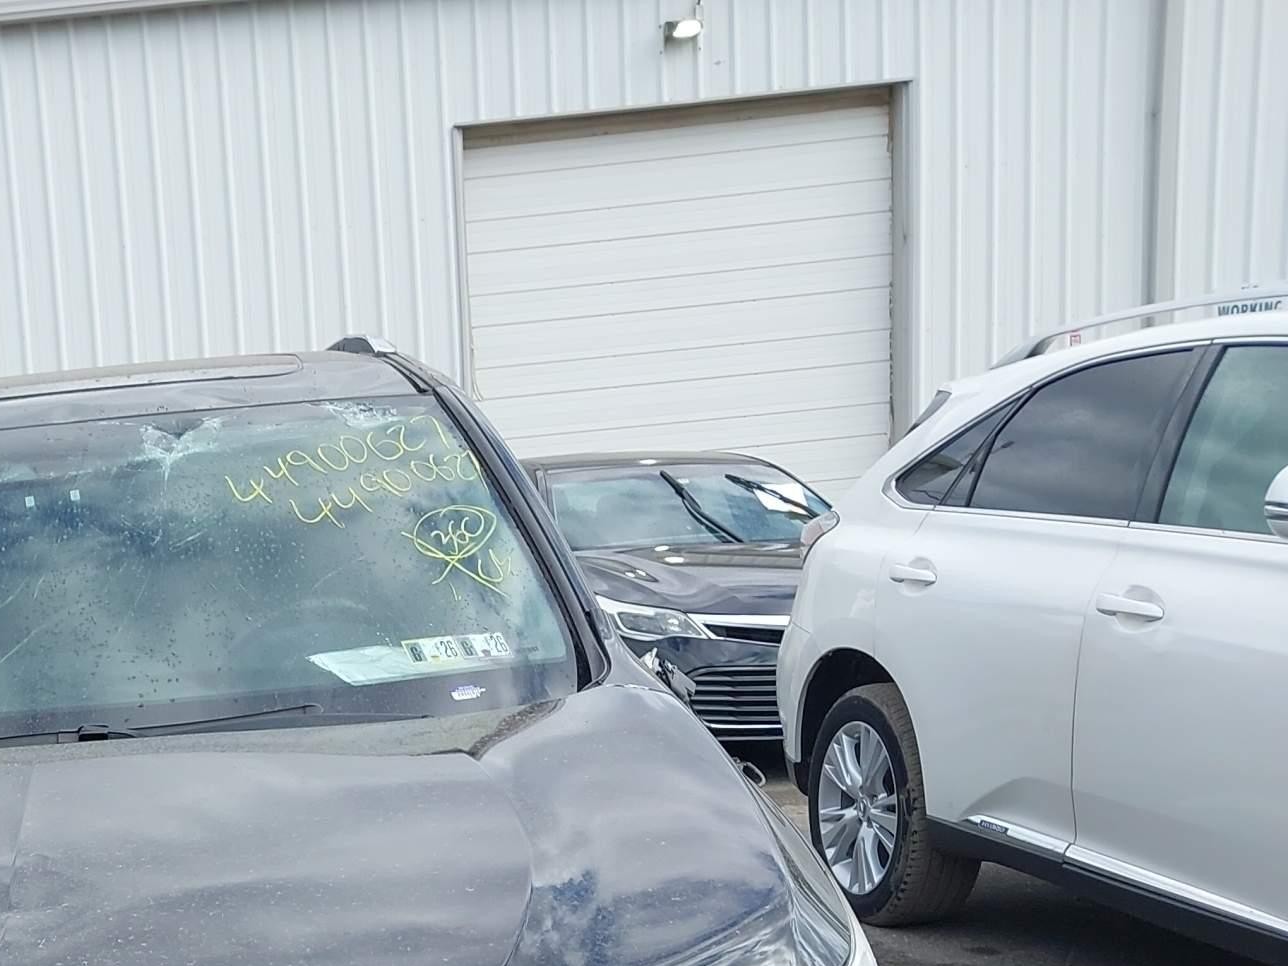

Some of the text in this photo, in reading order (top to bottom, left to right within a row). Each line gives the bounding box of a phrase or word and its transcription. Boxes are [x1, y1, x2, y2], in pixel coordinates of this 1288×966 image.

[224, 415, 451, 504] 44900627
[288, 448, 489, 529] 44900627
[440, 640, 458, 658] 26
[490, 635, 508, 653] 26
